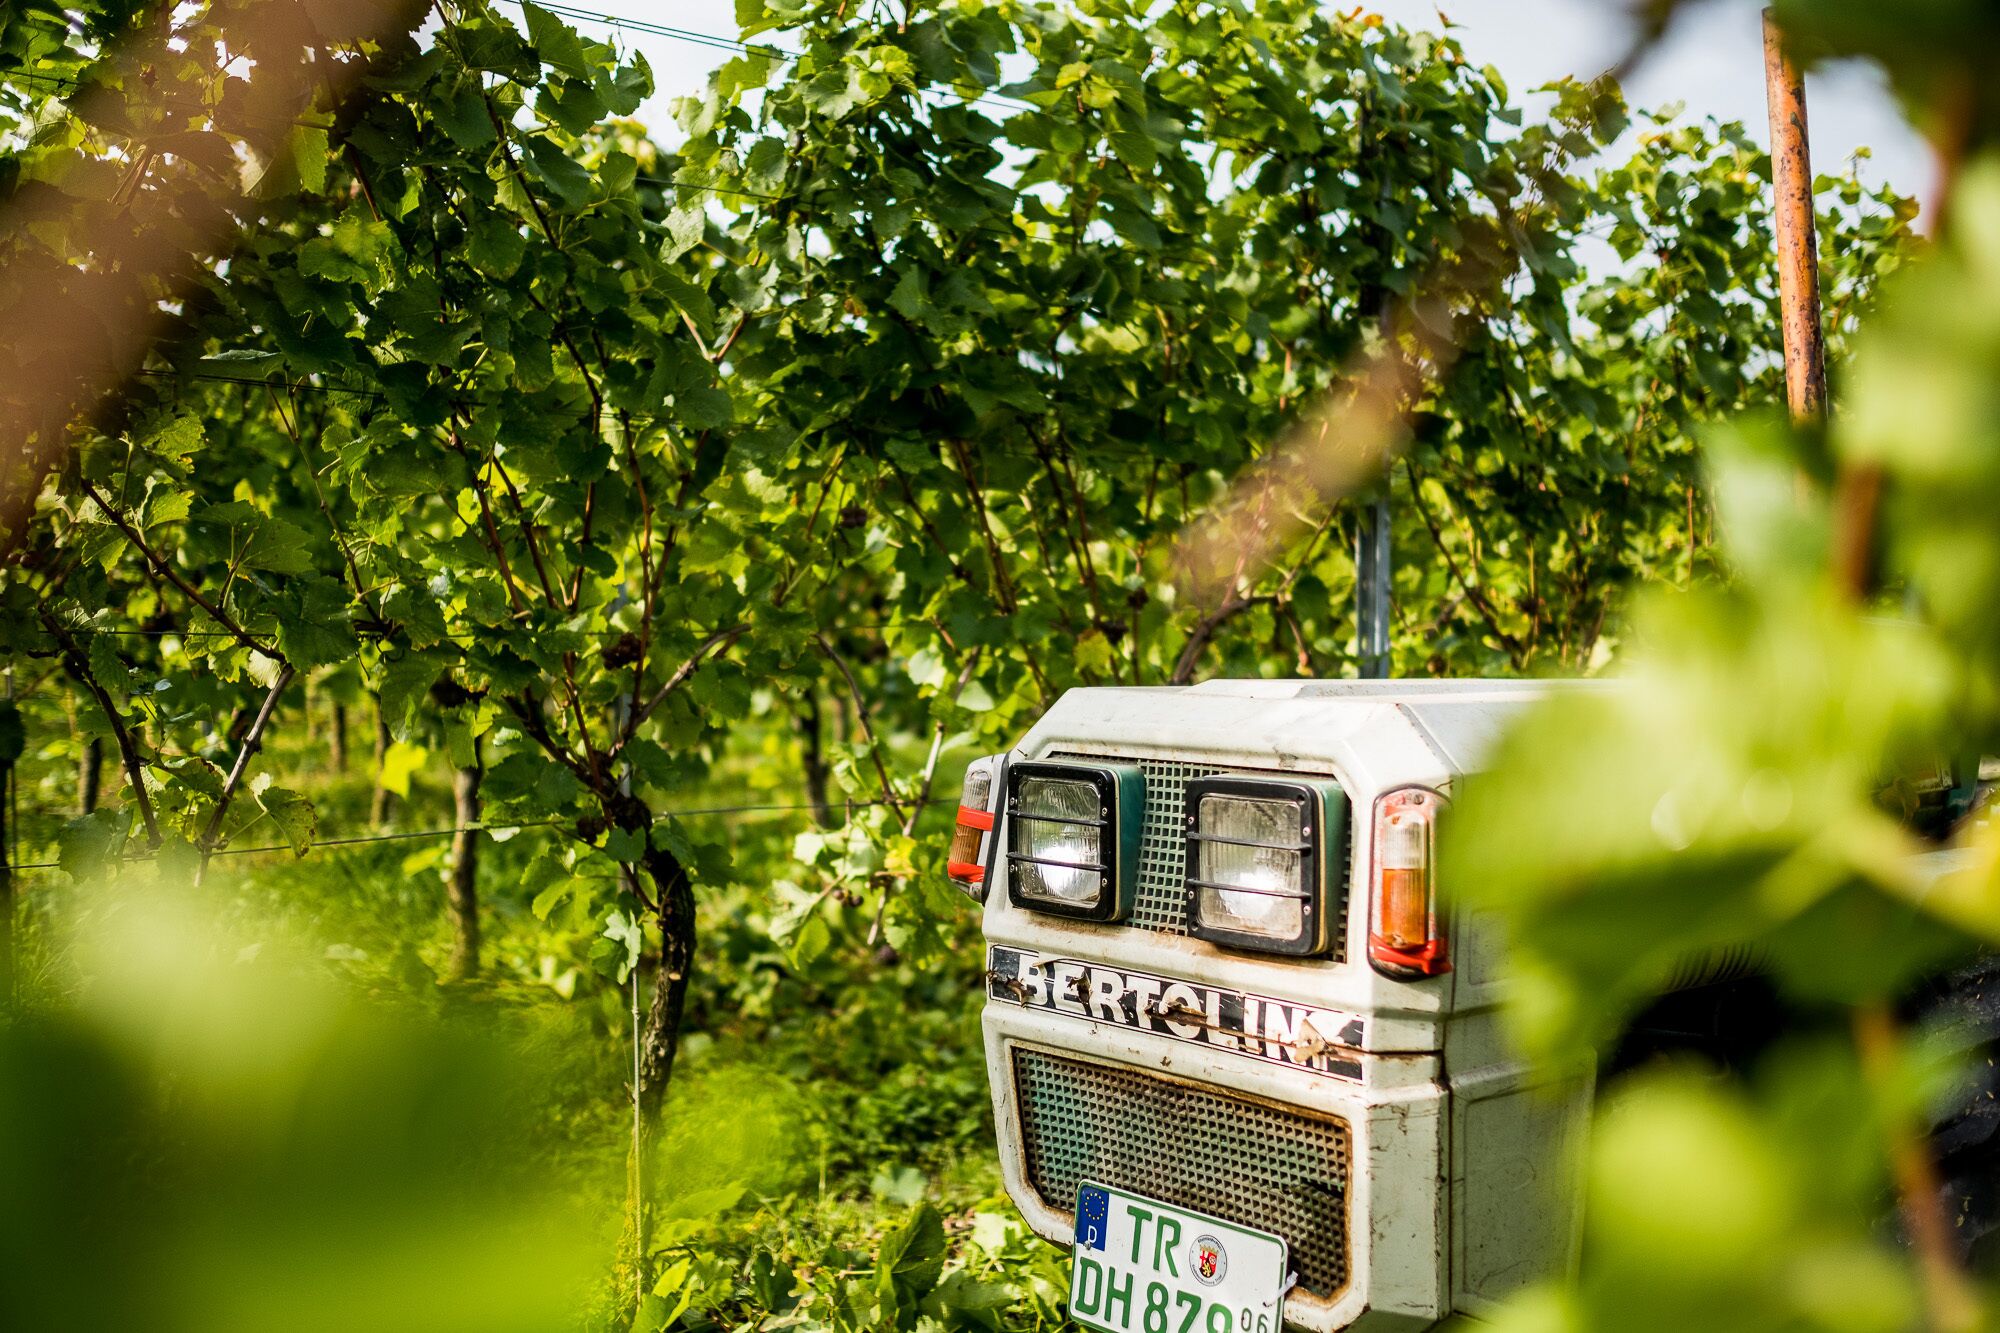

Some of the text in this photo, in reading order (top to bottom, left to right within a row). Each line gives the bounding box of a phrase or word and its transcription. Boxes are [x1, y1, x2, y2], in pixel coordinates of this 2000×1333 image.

[1087, 1225, 1098, 1244] D
[1126, 1204, 1182, 1278] TR
[1075, 1256, 1134, 1329] DH
